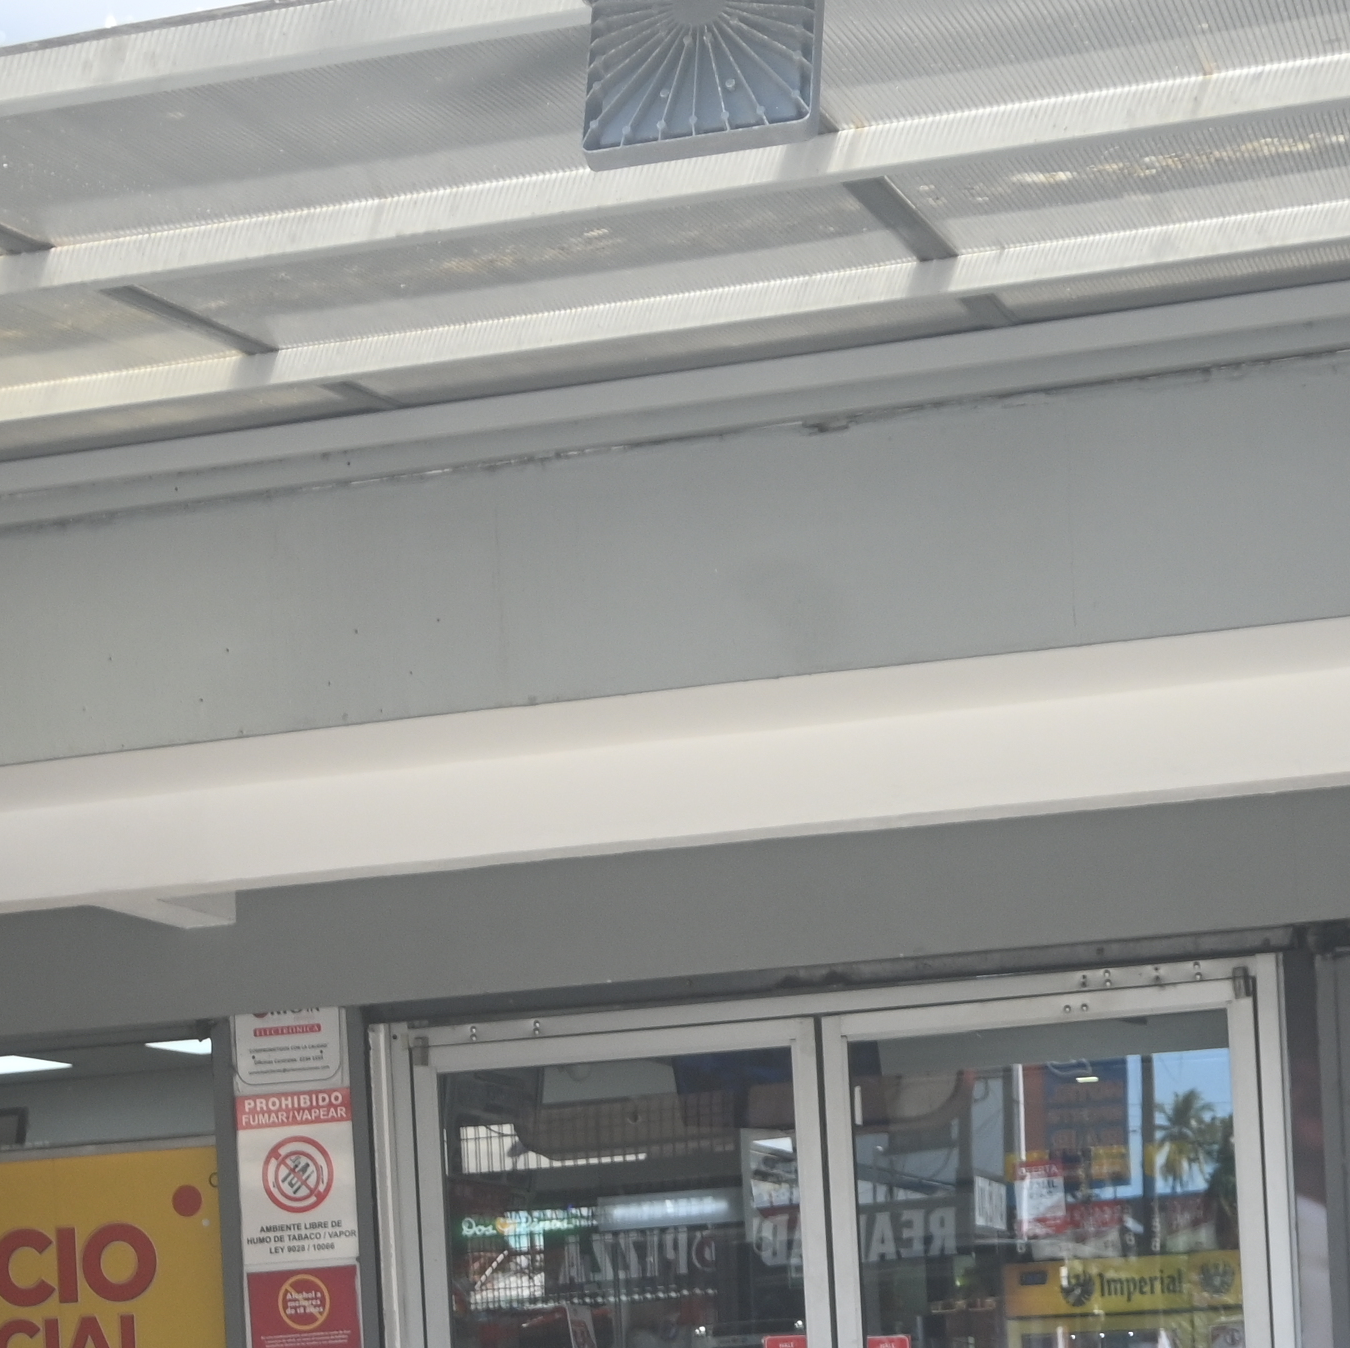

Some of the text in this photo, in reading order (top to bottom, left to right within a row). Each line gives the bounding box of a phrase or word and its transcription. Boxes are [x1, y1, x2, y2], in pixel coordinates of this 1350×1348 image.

[244, 1091, 343, 1112] PROHIBIDO
[259, 1219, 342, 1233] AMBIENTE LIBRE DE
[246, 1236, 271, 1245] HUMO
[273, 1234, 285, 1243] DE
[287, 1232, 321, 1241] TABACO
[328, 1229, 357, 1238] VAPOR
[269, 1246, 285, 1254] LEY
[287, 1244, 305, 1253] 9028
[1097, 1267, 1183, 1303] Imperial
[286, 1290, 315, 1300] Alcohol
[286, 1307, 295, 1315] de
